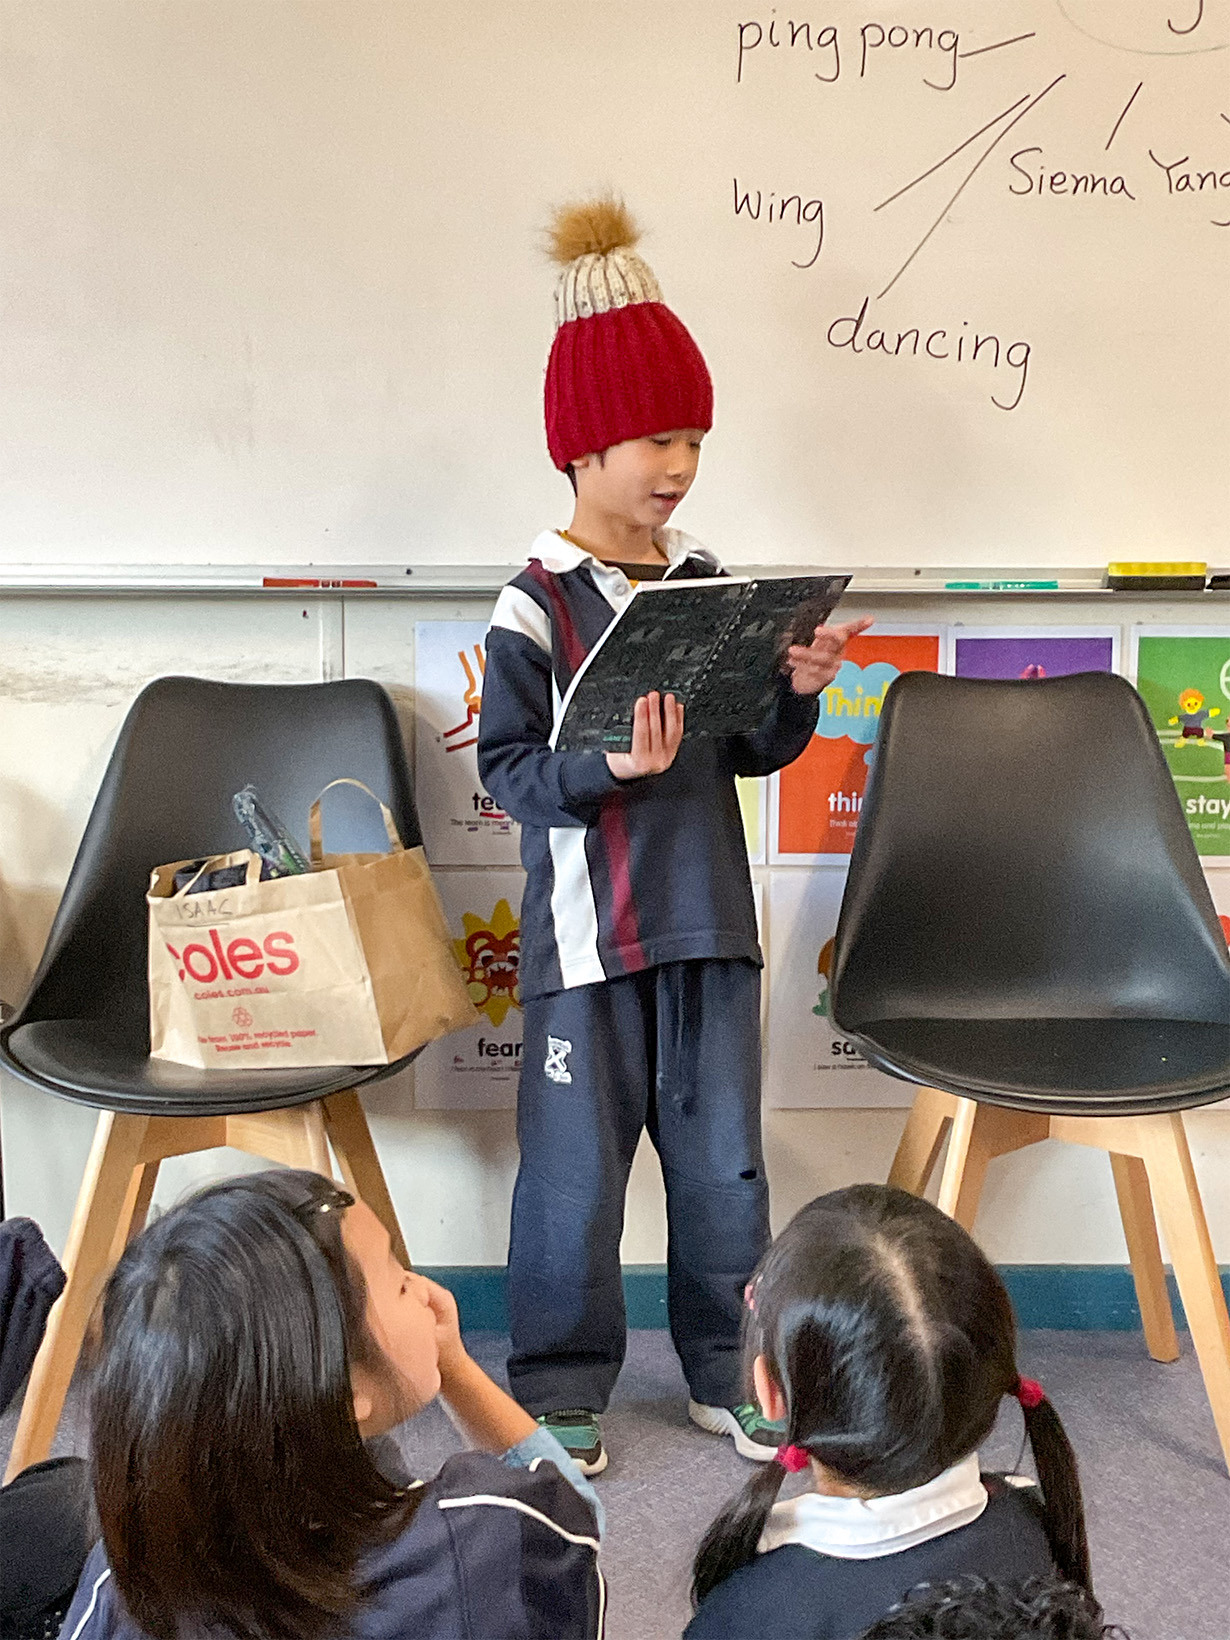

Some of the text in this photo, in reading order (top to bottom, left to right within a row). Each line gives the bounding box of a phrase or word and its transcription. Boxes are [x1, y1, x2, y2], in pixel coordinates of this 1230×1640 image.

[737, 8, 961, 90] ping pong
[1010, 147, 1136, 200] Sienna
[827, 296, 1031, 410] dancing
[824, 681, 890, 718] Thin
[1185, 794, 1230, 820] stay
[174, 898, 233, 920] ISAAC
[193, 986, 270, 1001] coles.com.au
